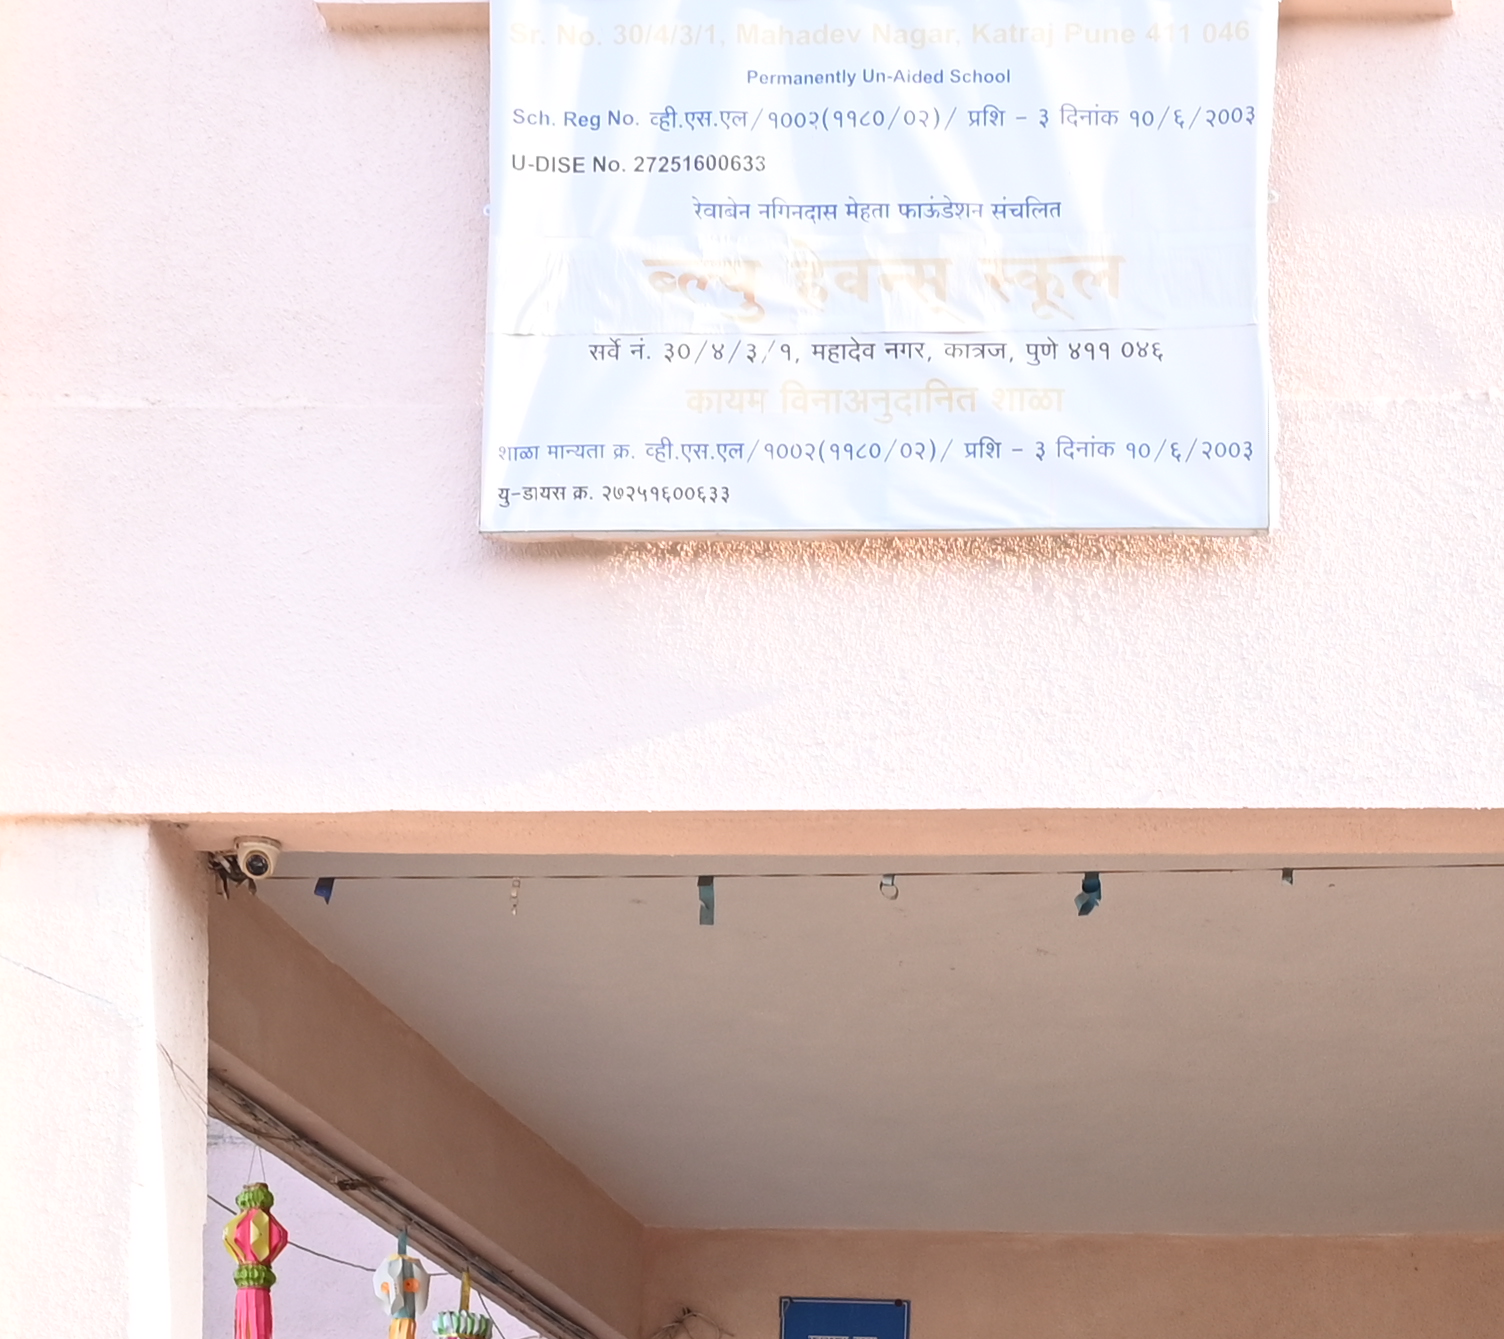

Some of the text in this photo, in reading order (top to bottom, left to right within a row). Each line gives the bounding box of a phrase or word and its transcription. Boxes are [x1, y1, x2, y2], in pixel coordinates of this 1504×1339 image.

[556, 24, 602, 46] No.
[736, 23, 862, 45] Mahadev
[873, 23, 961, 49] Nagar,
[1065, 23, 1135, 44] Pune
[1146, 22, 1190, 44] 411
[1203, 20, 1250, 43] 046
[747, 68, 1011, 87] Permanently Un-Aided School
[512, 108, 556, 127] Sch.
[564, 111, 601, 130] Reg
[607, 109, 640, 127] No.
[968, 104, 1005, 128] प्रशि
[1039, 108, 1049, 129] ३
[1059, 102, 1119, 128] दिनांक
[512, 154, 766, 173] U-DISE No. 27251600633
[692, 196, 750, 220] रेवाबेन
[757, 197, 837, 224] नगिनदास
[845, 196, 890, 220] मेहता
[991, 195, 1061, 220] संचलित
[589, 338, 621, 362] सर्वे
[630, 338, 651, 361] नं.
[812, 340, 875, 363] महादेव
[885, 341, 931, 362] नगर,
[944, 341, 1013, 363] कात्रज,
[1026, 337, 1058, 365] पुणे
[1069, 341, 1110, 361] ४११
[1121, 341, 1164, 362] ०४६
[686, 387, 768, 414] कायम
[992, 387, 1064, 413] शाळा
[498, 444, 539, 461] शाळा
[547, 443, 605, 461] मान्यता
[613, 443, 635, 461] क्र.
[964, 435, 1001, 460] प्रशि
[1035, 440, 1045, 462] ३
[1055, 435, 1115, 460] दिनांक
[573, 486, 593, 502] क्र.
